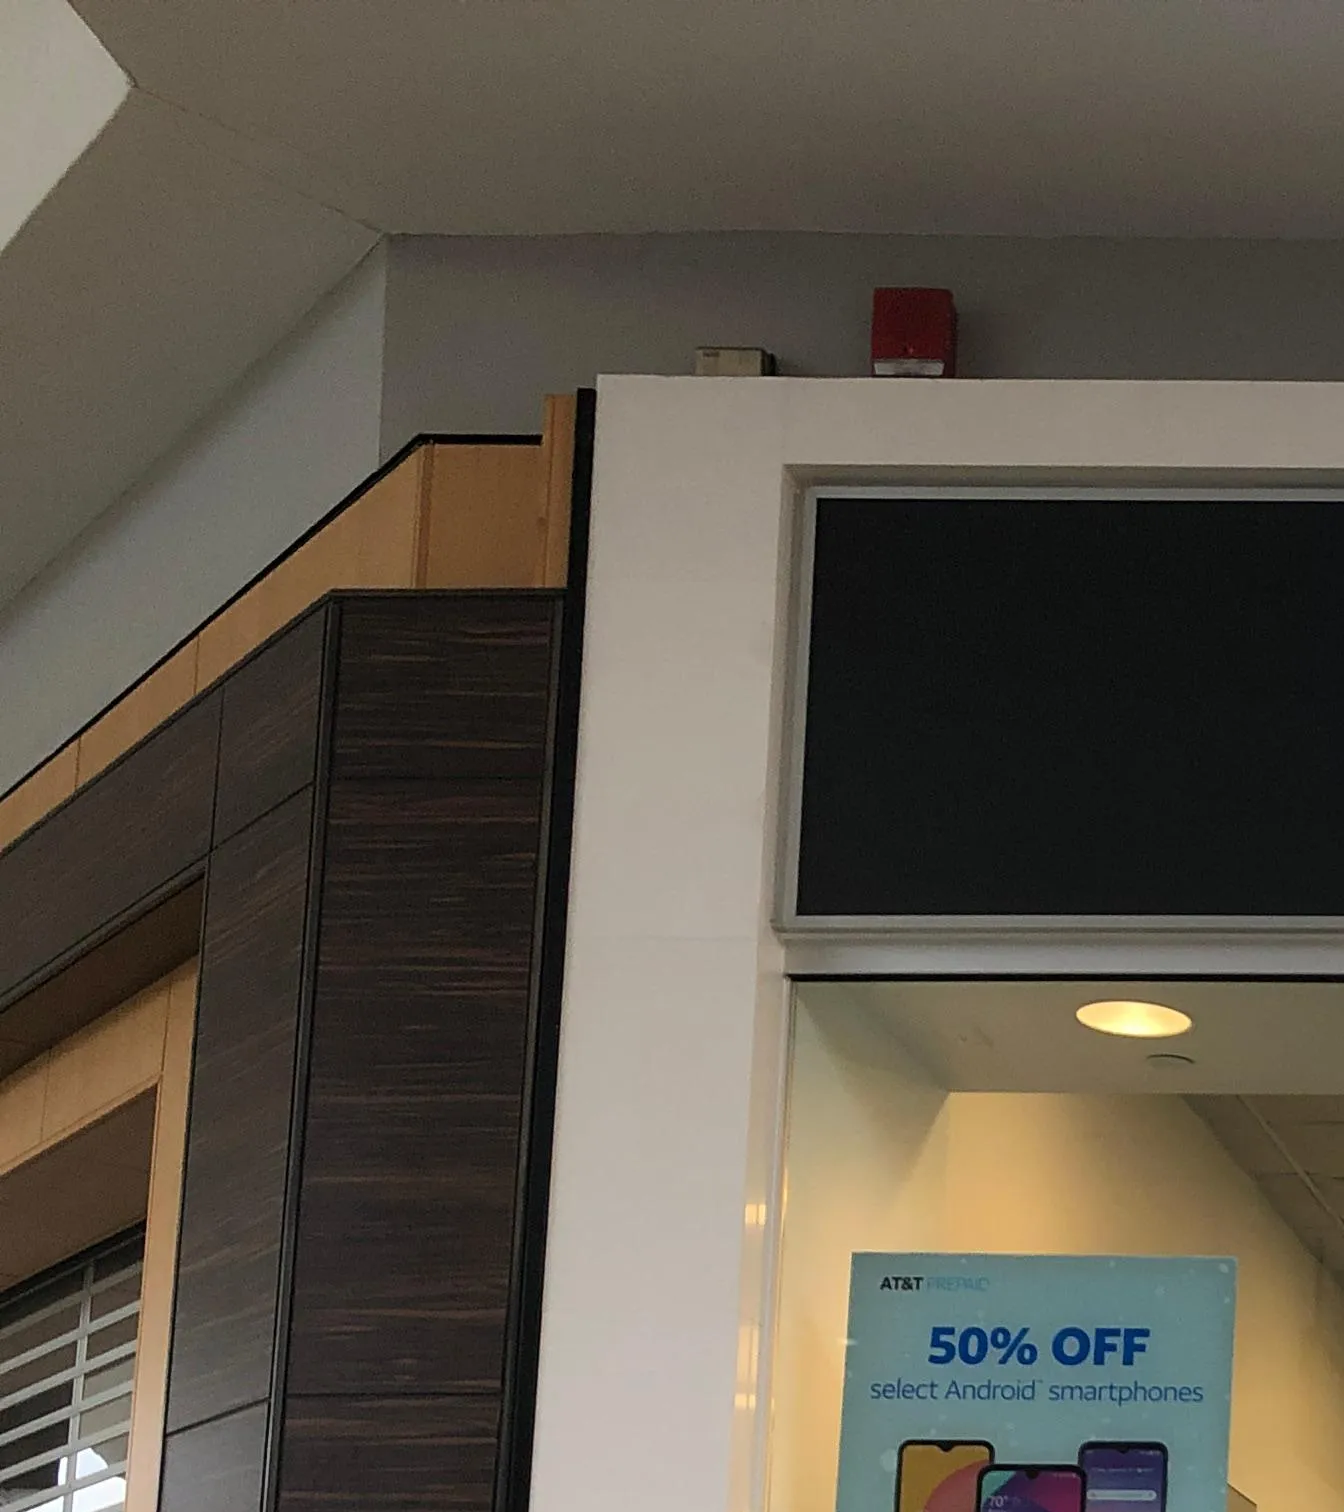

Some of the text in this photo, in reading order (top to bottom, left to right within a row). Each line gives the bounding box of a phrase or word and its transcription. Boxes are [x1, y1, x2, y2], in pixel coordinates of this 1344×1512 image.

[880, 1276, 989, 1290] AT&T PREPAID
[928, 1327, 1150, 1366] 50% OFF
[870, 1379, 938, 1401] select
[1049, 1381, 1203, 1407] smartphones
